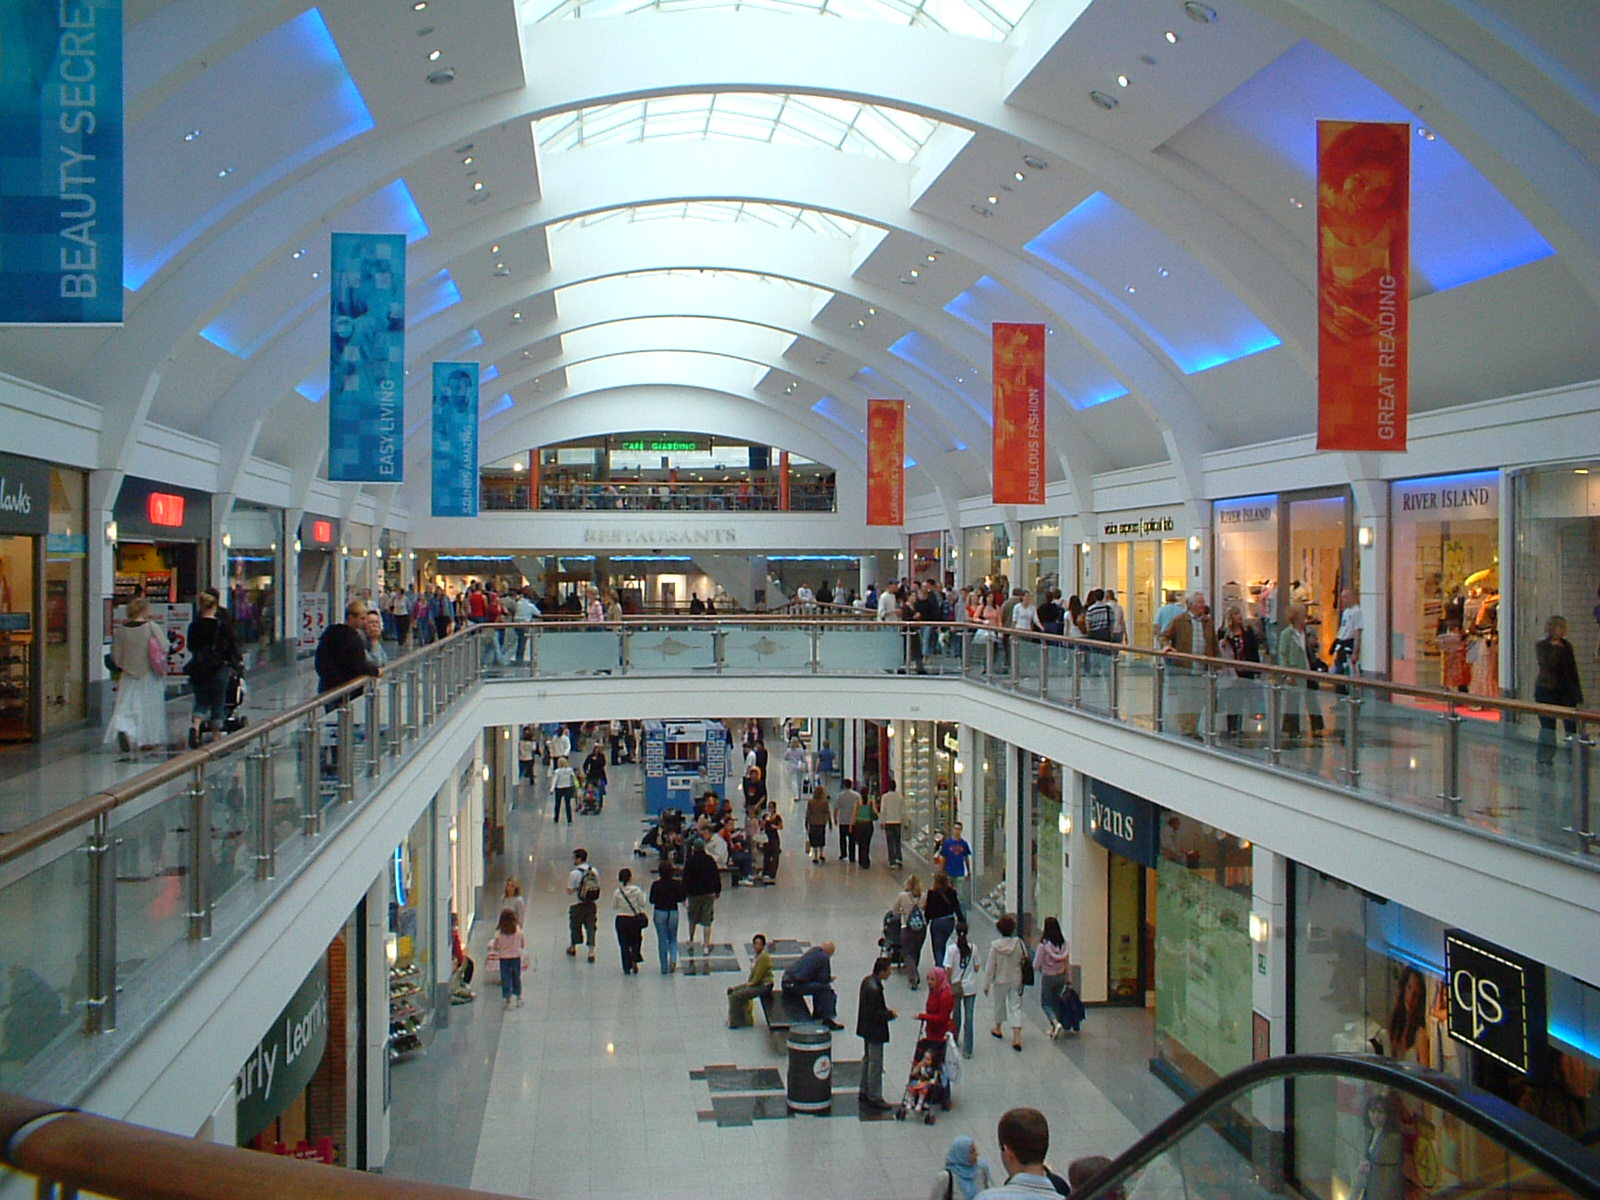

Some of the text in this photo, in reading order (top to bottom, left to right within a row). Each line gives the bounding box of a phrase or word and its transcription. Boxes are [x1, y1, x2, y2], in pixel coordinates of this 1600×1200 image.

[59, 0, 97, 299] BEAUTY SECRE
[1378, 275, 1397, 440] GREAT READING
[379, 379, 395, 475] EASY LIVING
[1028, 388, 1040, 502] FABULOUS FASHION
[1219, 507, 1272, 525] RIVER ISLAND
[1403, 488, 1489, 511] RIVER ISLAND
[584, 528, 737, 544] RESTAURANTS
[1090, 793, 1134, 842] Evans
